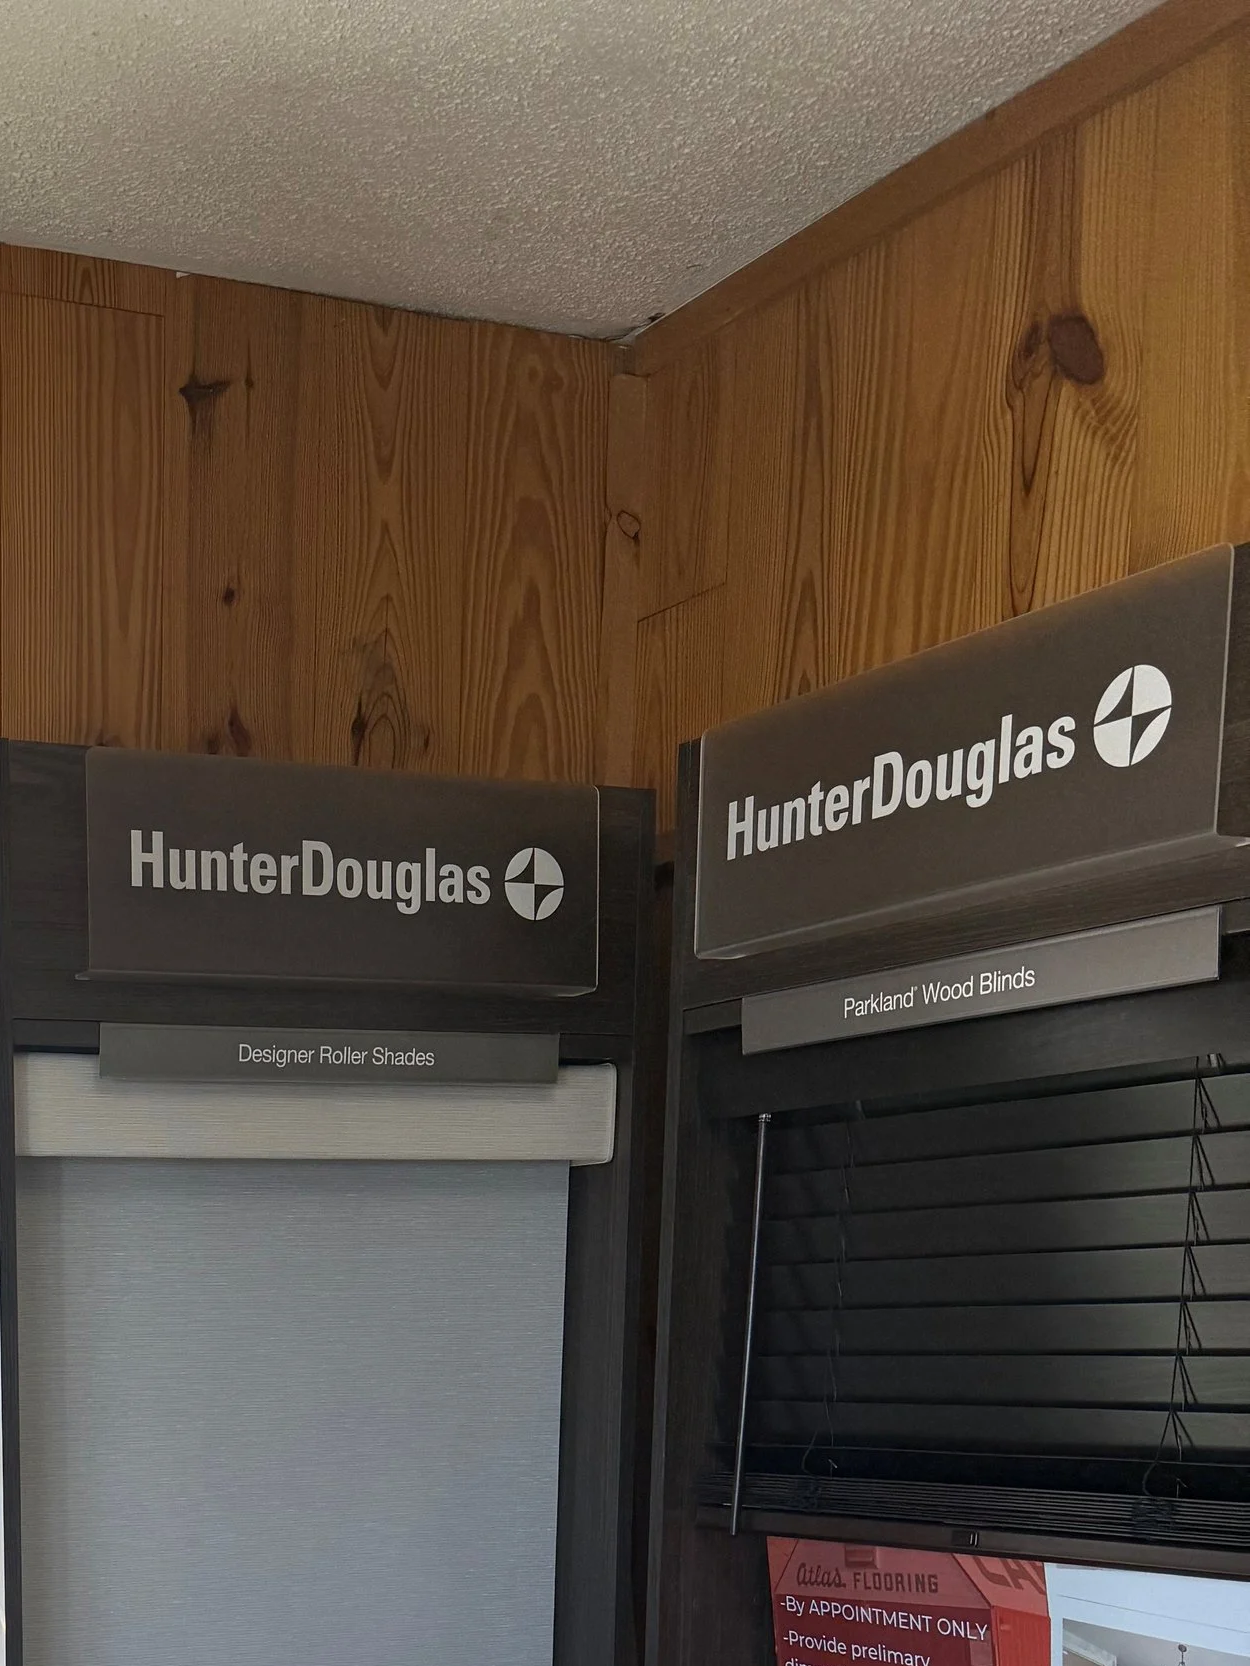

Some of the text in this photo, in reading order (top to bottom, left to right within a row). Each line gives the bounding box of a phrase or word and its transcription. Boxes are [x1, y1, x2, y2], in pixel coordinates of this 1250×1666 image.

[727, 714, 1076, 861] HunterDouglas
[130, 829, 491, 915] HunterDouglas
[922, 975, 974, 1005] Wood
[979, 966, 1036, 996] Blinds
[238, 1043, 435, 1068] Designer Roller Shades
[853, 1571, 939, 1594] FLOORING
[780, 1595, 988, 1641] -By APPOINTMENT ONLY
[783, 1630, 847, 1655] -Provide
